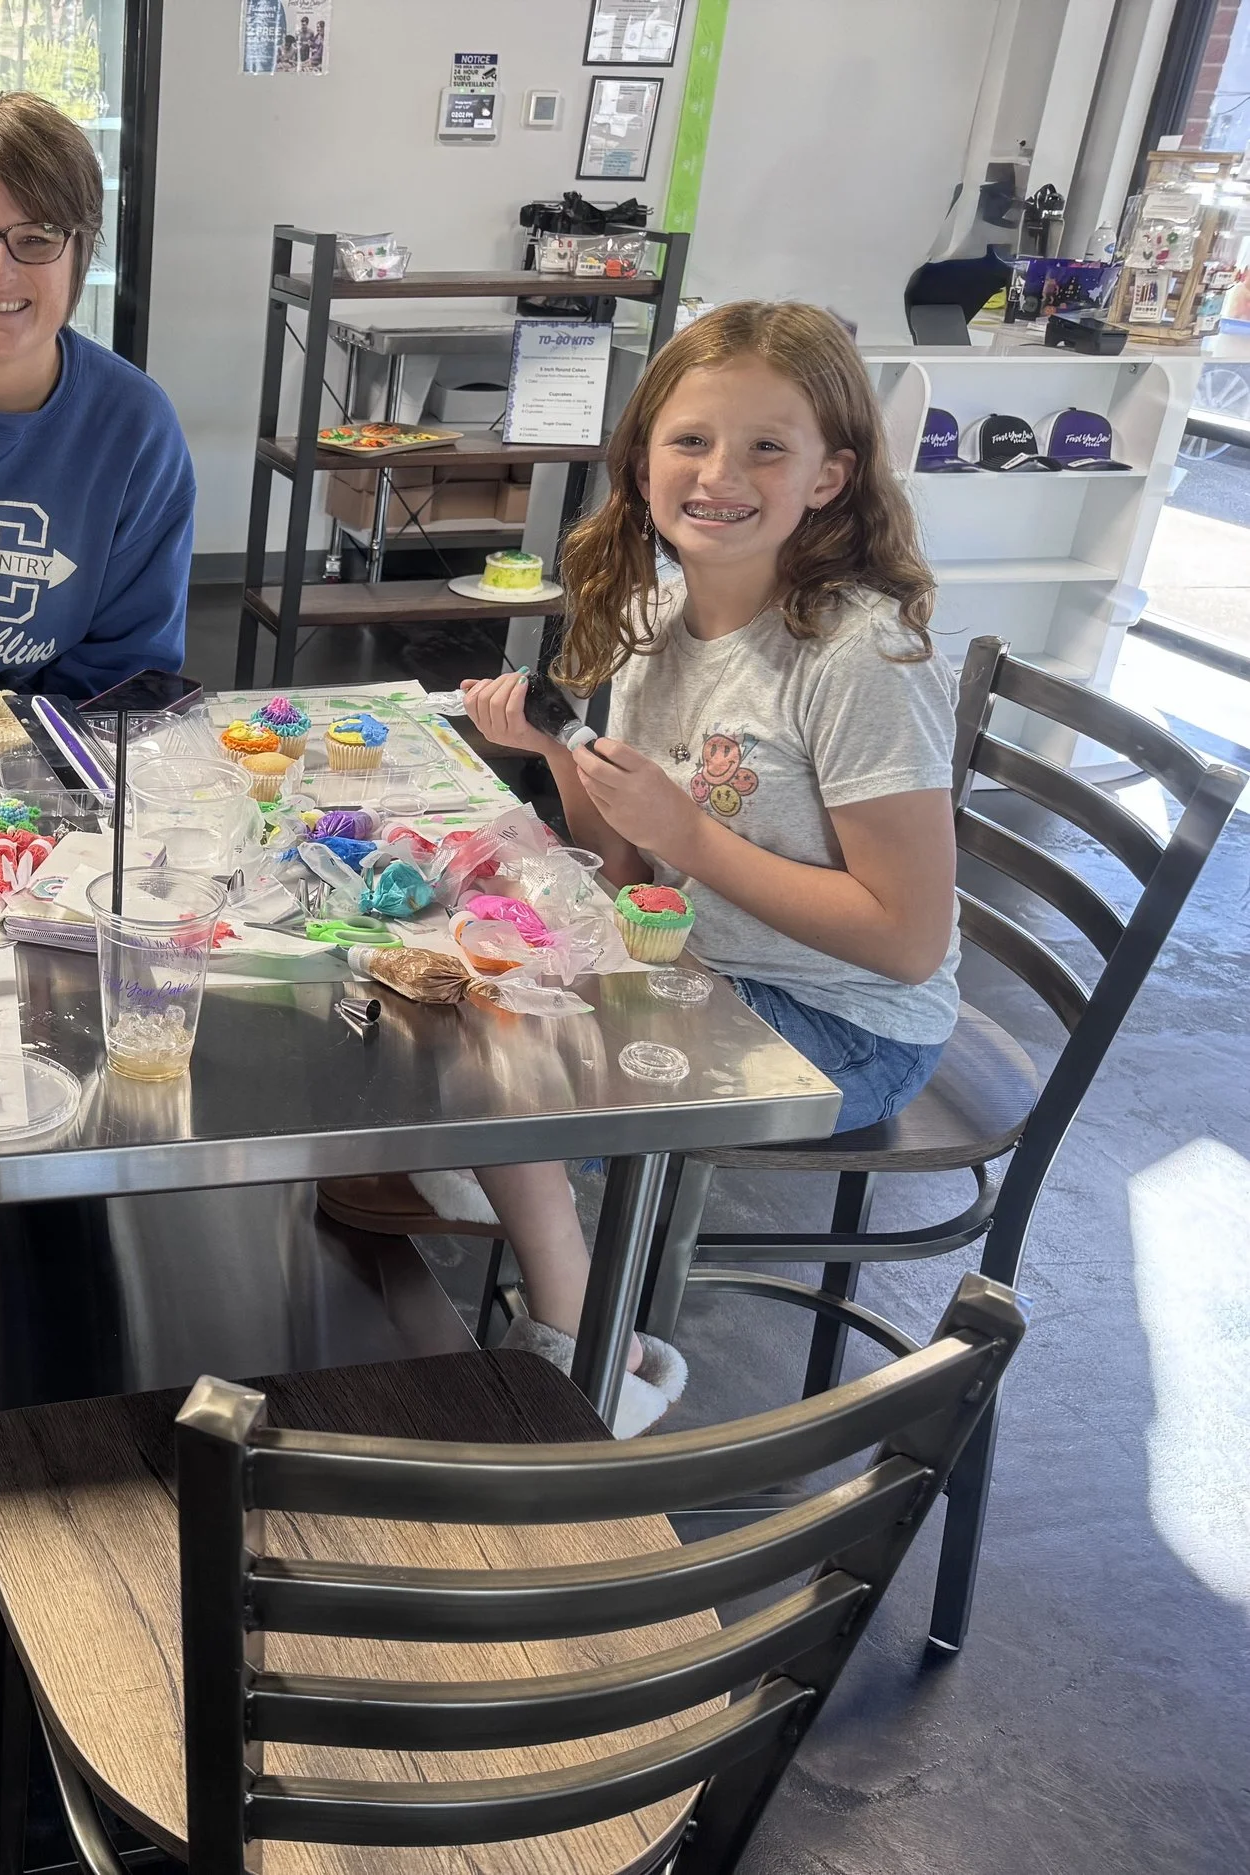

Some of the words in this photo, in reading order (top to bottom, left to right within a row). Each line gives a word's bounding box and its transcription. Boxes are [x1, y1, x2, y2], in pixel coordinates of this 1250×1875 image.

[461, 55, 491, 64] NOTICE
[538, 335, 570, 346] TO-GO
[570, 335, 596, 346] KITS
[126, 980, 155, 998] Your
[158, 977, 194, 998] Cake
